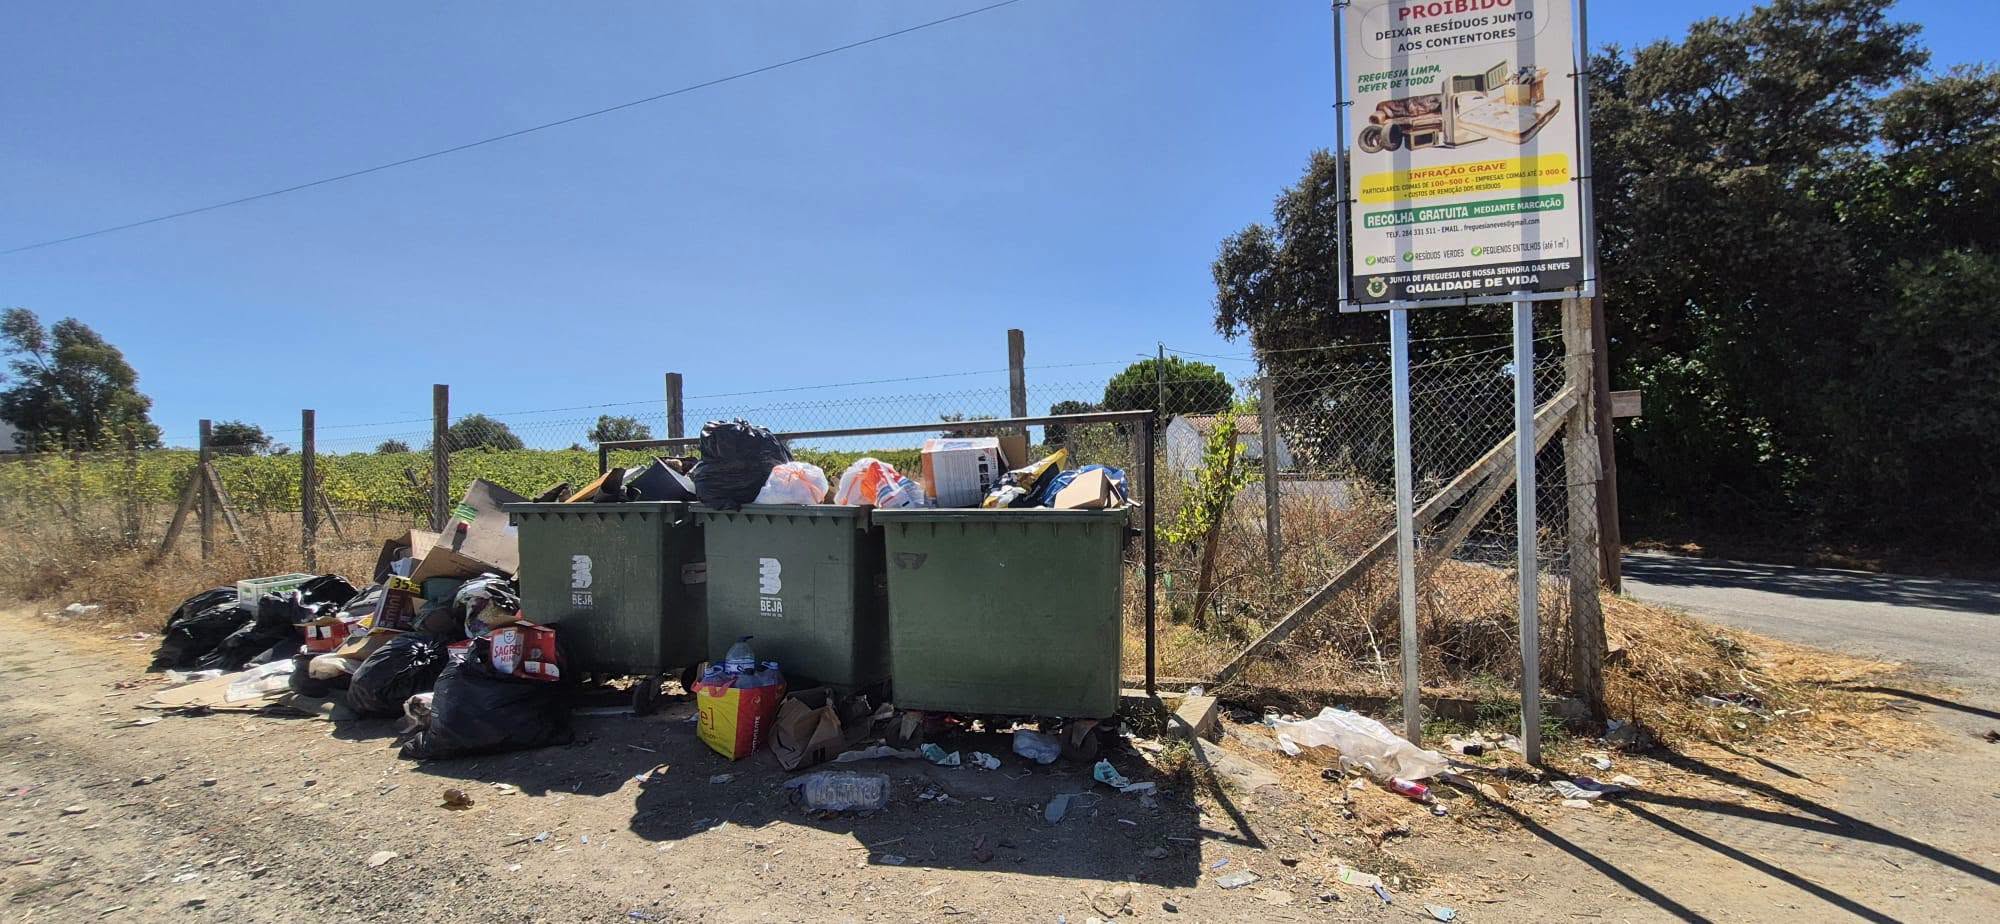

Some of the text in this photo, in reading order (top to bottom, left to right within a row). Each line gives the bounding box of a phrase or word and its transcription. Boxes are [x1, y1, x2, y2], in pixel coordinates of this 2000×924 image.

[1375, 10, 1533, 41] DEIXAR RESÍDUOS JUNTO
[1397, 28, 1516, 53] AOS CONTENTORES
[1358, 69, 1408, 83] FREGUESIA
[1358, 75, 1435, 93] DEVER DE TODOS
[1408, 162, 1506, 180] INFRAÇÃO GRAVE
[1367, 198, 1562, 227] RECOLHA GRATUITA MEDIANTE MARCAÇÃO
[1402, 229, 1412, 237] 284
[1425, 227, 1436, 235] 511
[1415, 249, 1465, 261] RESÍDUOS VERDES
[1482, 244, 1512, 255] PEQUENOS
[1513, 241, 1541, 252] ENTULHOS
[1376, 255, 1396, 264] MONOS
[1389, 276, 1411, 284] JUNTA
[1422, 271, 1461, 281] FREGUESIA
[1461, 270, 1471, 278] DE
[1472, 268, 1496, 277] NOSSA
[1496, 265, 1530, 275] SENHORA
[1531, 264, 1546, 272] DAS
[1547, 262, 1571, 271] NEVES
[1406, 274, 1540, 294] QUALIDADE DE VIDA
[572, 594, 593, 606] BEJA
[760, 600, 783, 613] BEJA
